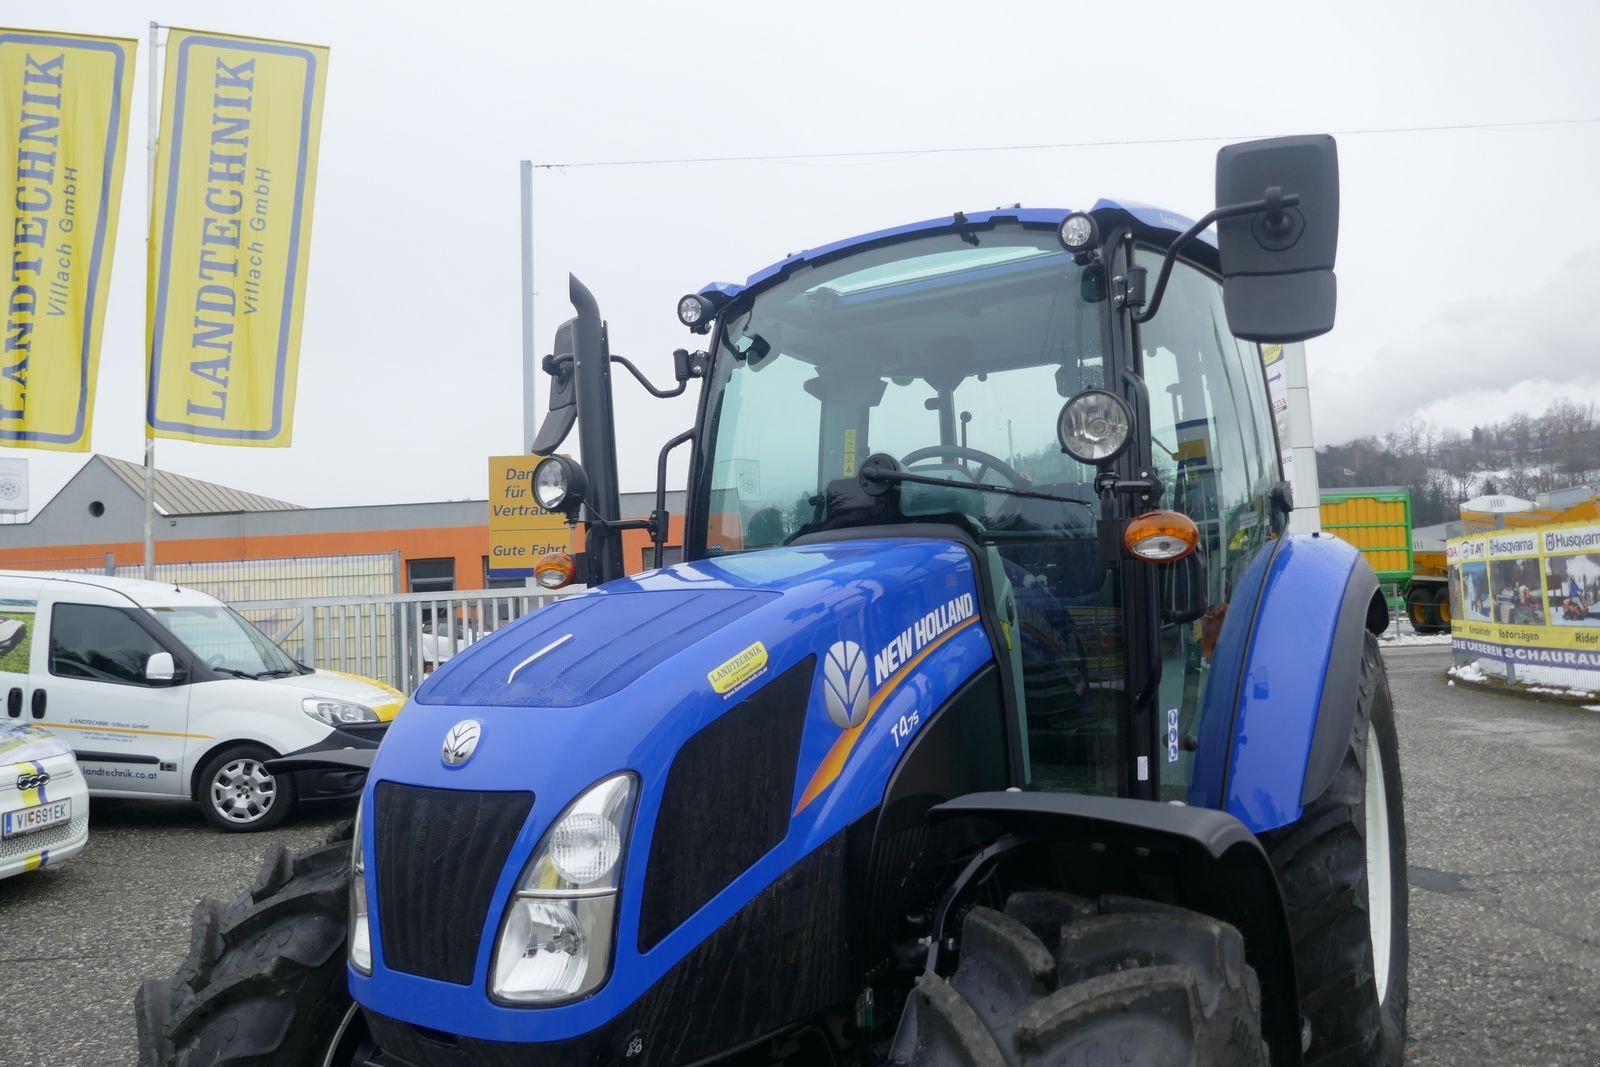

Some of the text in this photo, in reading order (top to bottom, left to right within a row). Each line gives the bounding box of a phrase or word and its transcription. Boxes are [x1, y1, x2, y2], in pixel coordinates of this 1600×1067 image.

[0, 53, 65, 422] LANDTECHNIK
[46, 166, 78, 316] Villach GmbH
[186, 57, 256, 421] LANDTECHNIK
[243, 166, 272, 315] Villach GmbH
[505, 468, 534, 481] Dan
[504, 485, 527, 498] für
[493, 505, 567, 517] Vertrau
[1493, 539, 1534, 555] Husqvarna
[1555, 532, 1600, 549] Husqvarn
[493, 543, 567, 556] Gute Fahrt
[874, 592, 974, 687] NEW HOLLAND
[1575, 632, 1599, 644] Rider
[710, 644, 763, 682] LANDTECHNIK
[17, 773, 50, 790] 500
